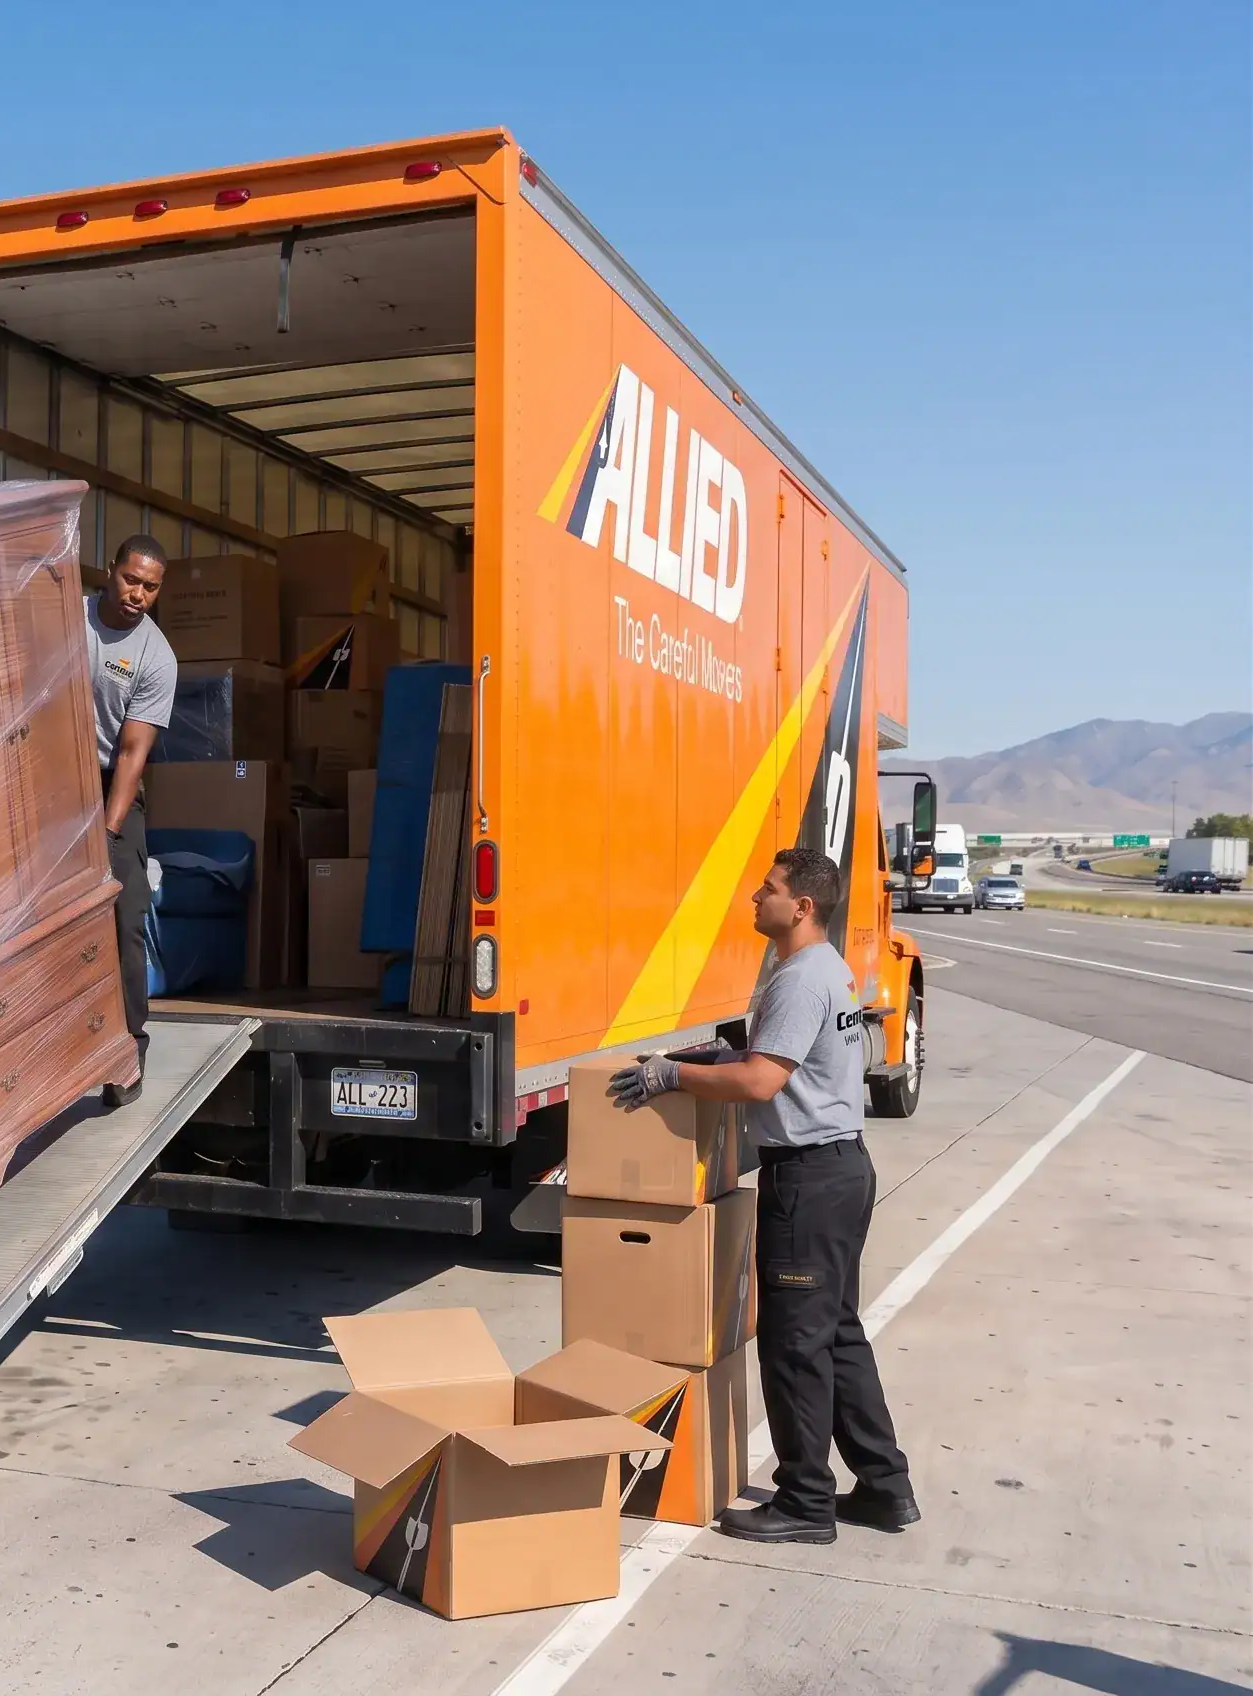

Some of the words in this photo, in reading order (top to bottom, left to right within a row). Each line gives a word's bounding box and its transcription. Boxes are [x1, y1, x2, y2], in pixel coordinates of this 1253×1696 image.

[580, 363, 748, 624] ALLIED
[614, 595, 645, 664] The
[337, 1081, 367, 1106] ALL
[377, 1084, 408, 1109] 223
